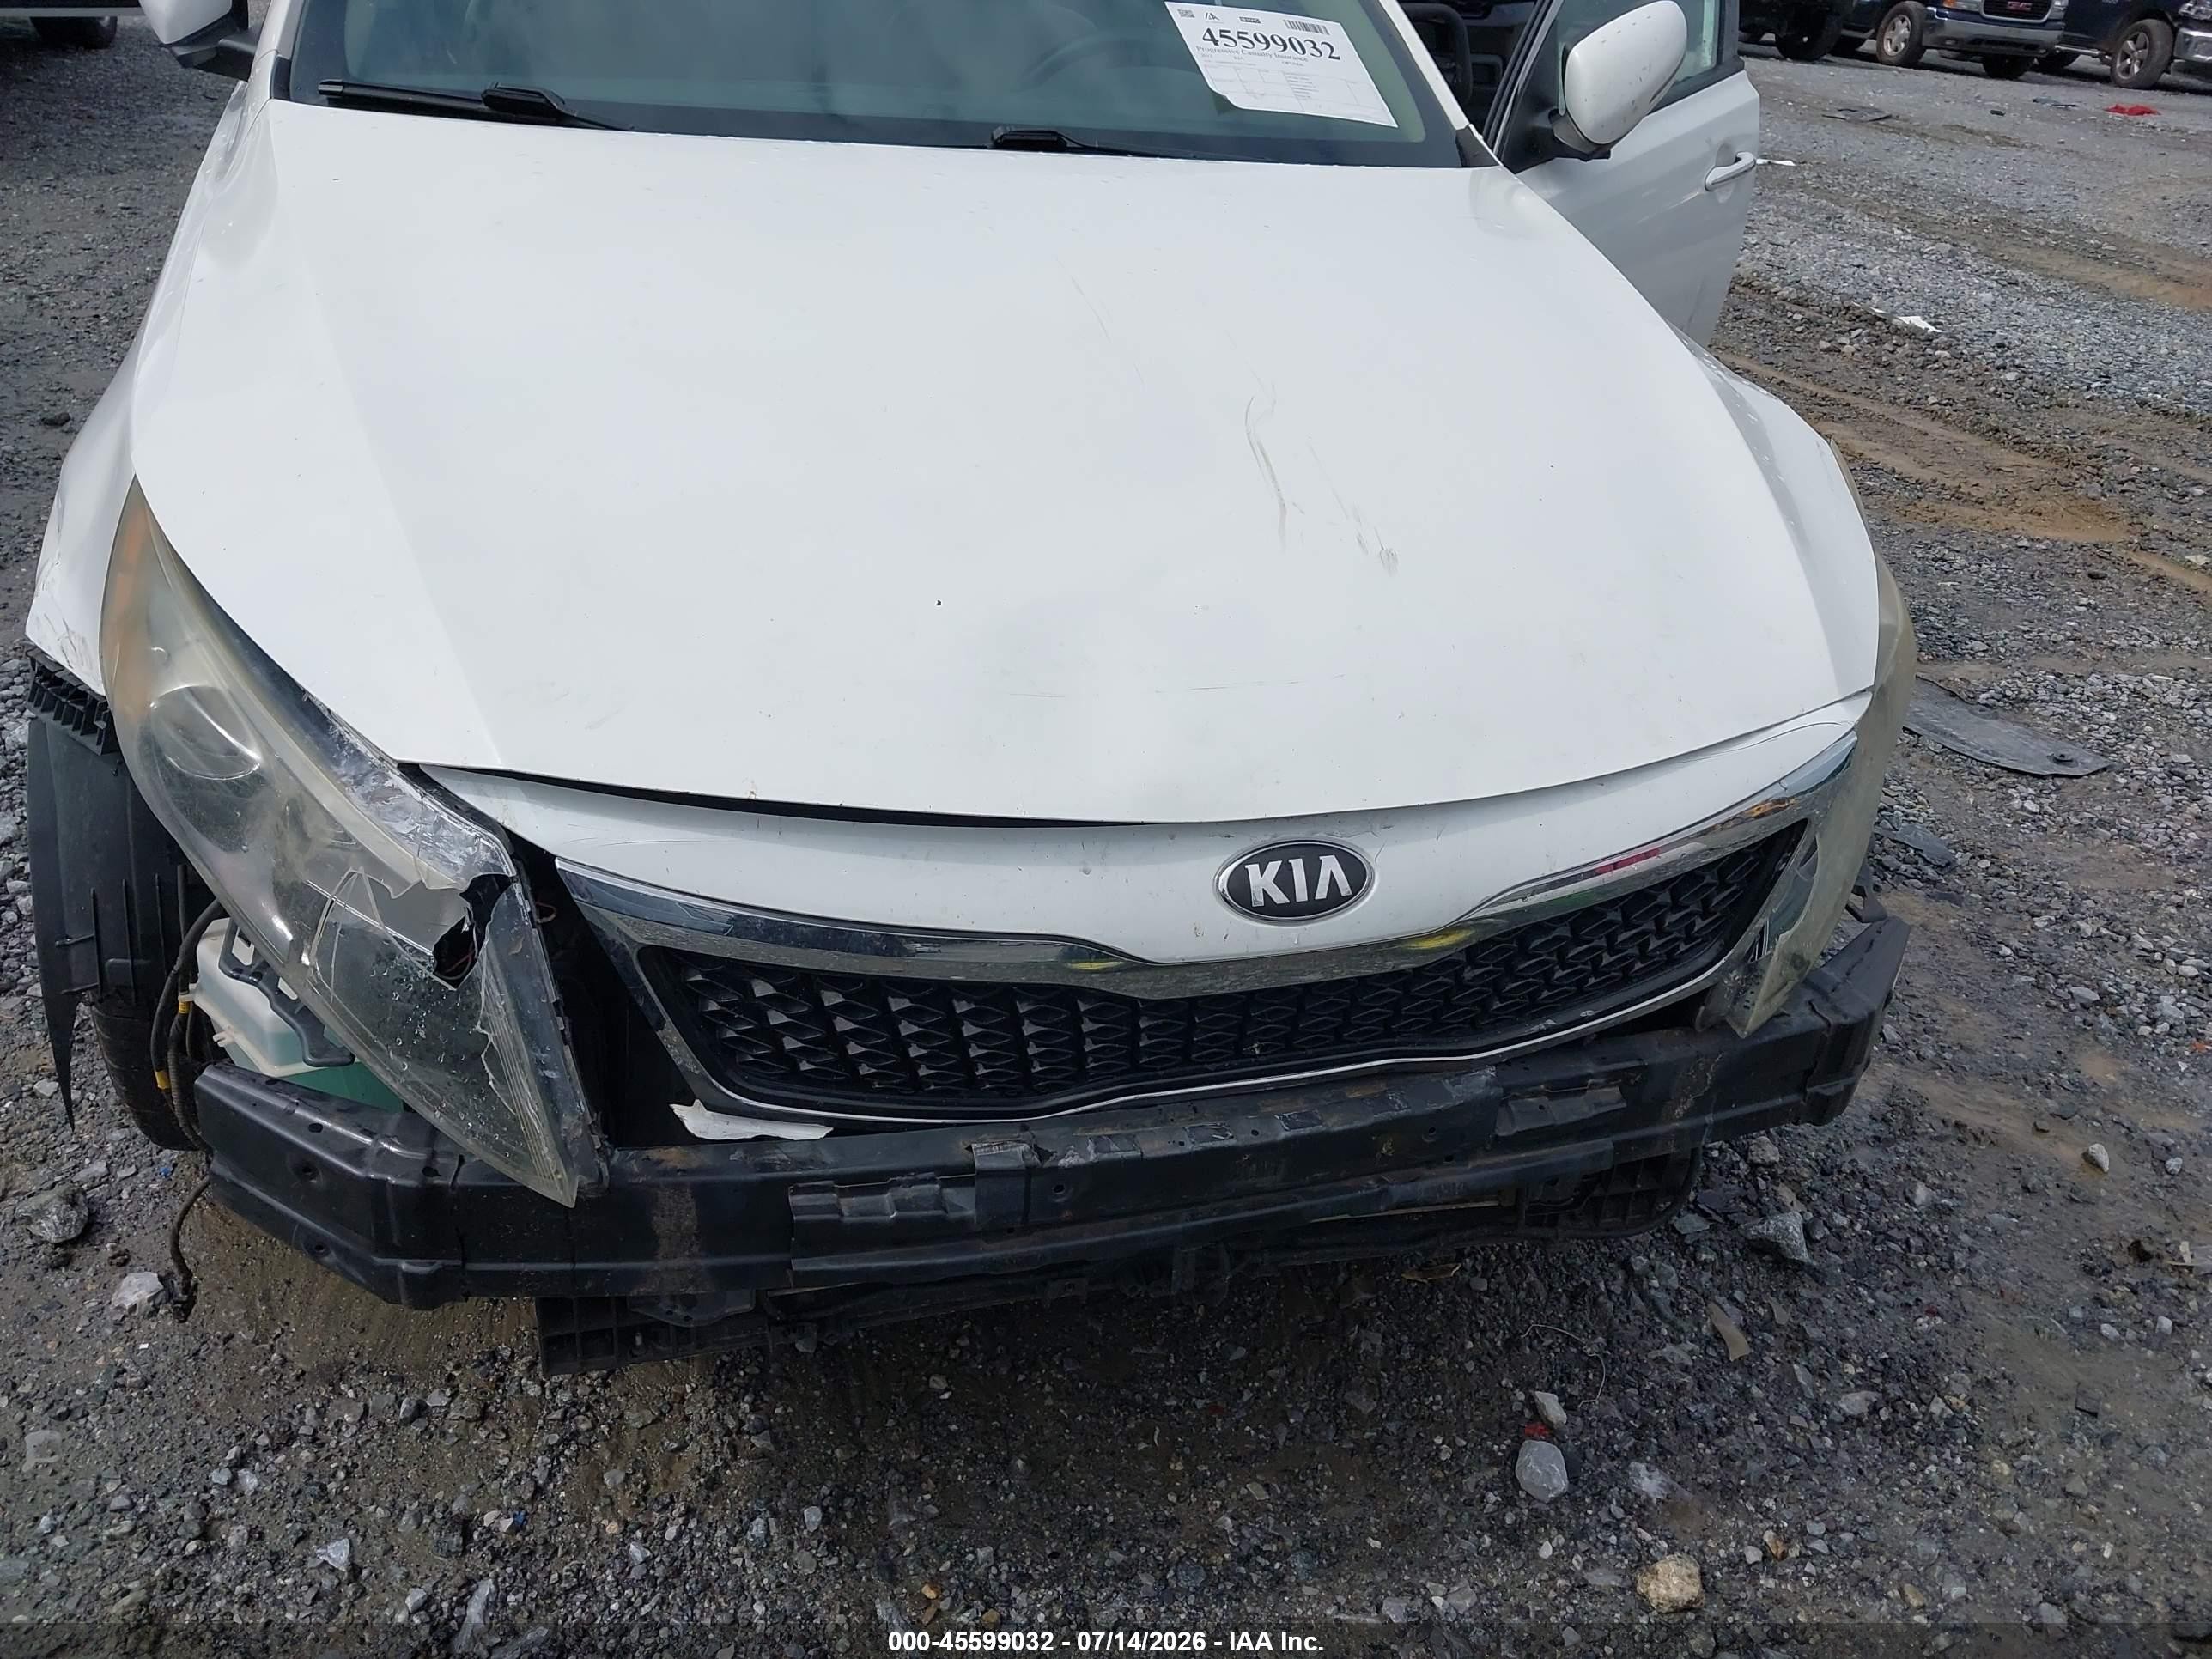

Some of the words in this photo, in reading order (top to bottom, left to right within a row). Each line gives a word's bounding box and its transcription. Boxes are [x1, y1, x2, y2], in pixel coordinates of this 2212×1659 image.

[1196, 45, 1240, 55] Progressive
[1202, 27, 1341, 62] 45599032
[1244, 854, 1352, 908] KIA
